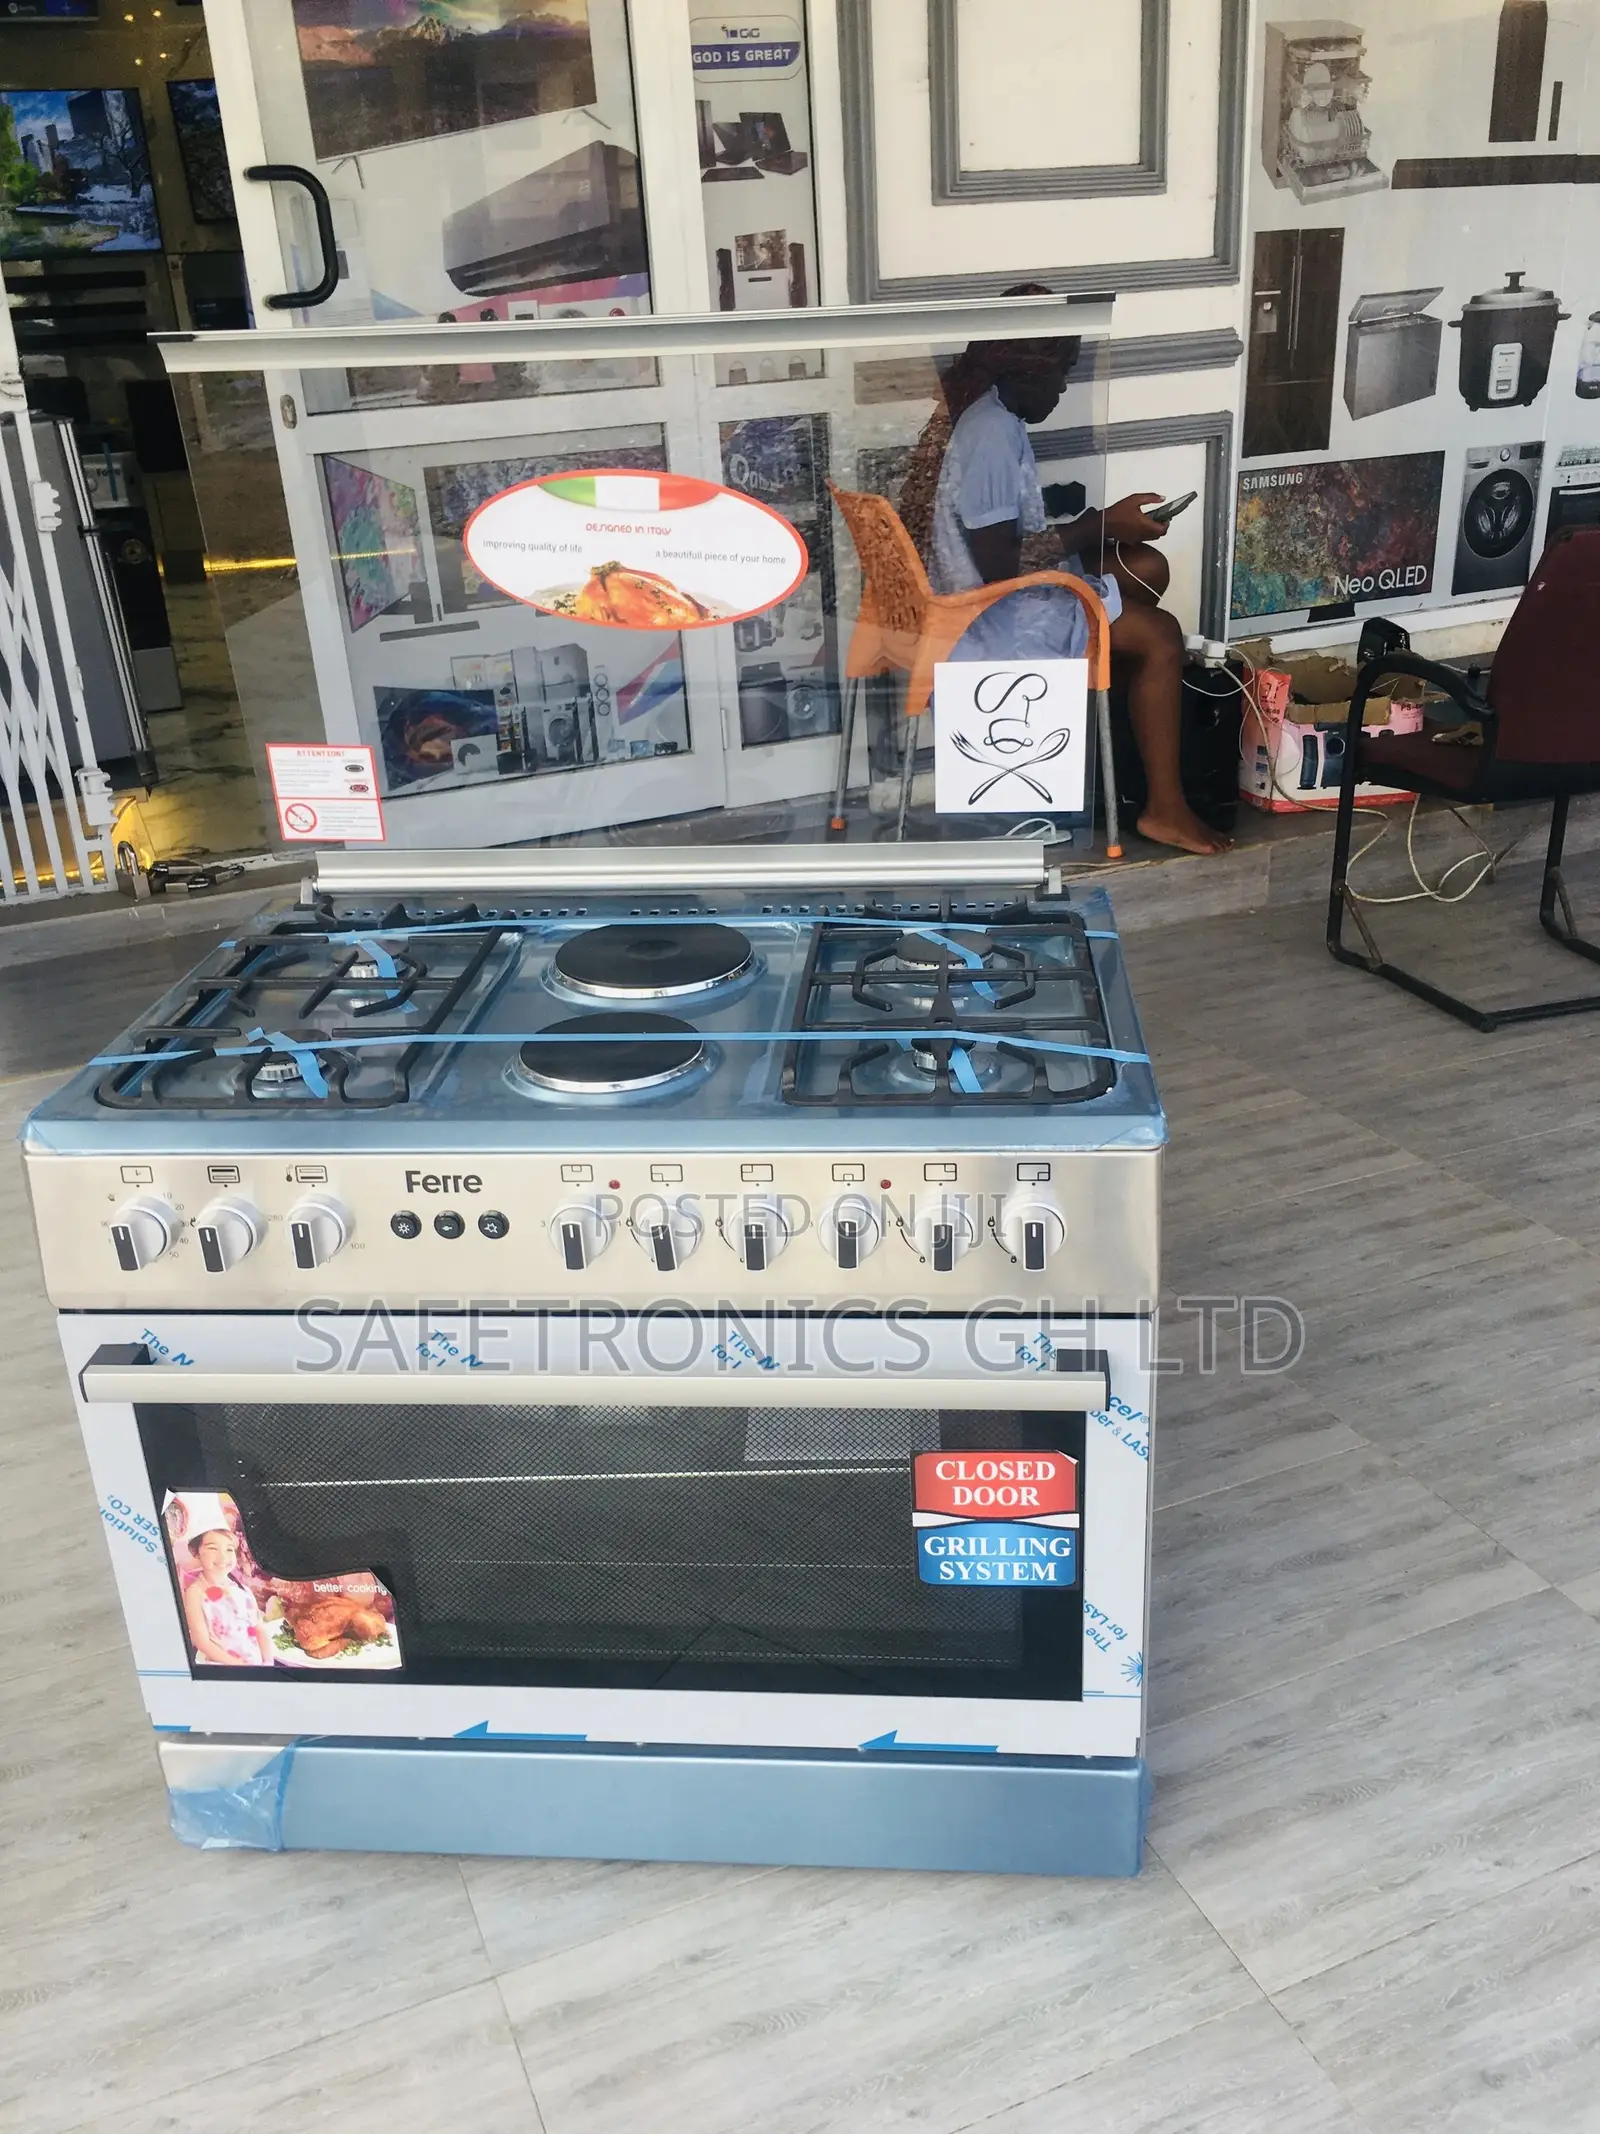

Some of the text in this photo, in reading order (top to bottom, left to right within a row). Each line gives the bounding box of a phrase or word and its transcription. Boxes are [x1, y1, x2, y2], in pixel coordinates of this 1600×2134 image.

[692, 48, 792, 63] GOD IS GREAT
[1242, 472, 1303, 490] SAMSUNG
[585, 523, 672, 536] DESIGNED IN ITALY
[483, 540, 583, 554] improving quality of life
[662, 550, 703, 560] beautifull
[704, 551, 727, 562] piece
[730, 553, 739, 562] of
[740, 554, 760, 564] your
[762, 555, 787, 564] home
[1333, 564, 1427, 596] Neo QLED
[404, 1169, 483, 1194] Ferre
[175, 1203, 185, 1211] 20
[141, 1328, 169, 1355] The
[416, 1342, 439, 1360] for
[431, 1328, 459, 1356] The
[728, 1330, 756, 1358] The
[1033, 1332, 1057, 1360] The
[711, 1344, 734, 1363] for
[1015, 1345, 1038, 1364] for
[1122, 1432, 1149, 1461] LAS
[935, 1460, 1056, 1481] CLOSED
[952, 1486, 1041, 1506] DOOR
[924, 1536, 1072, 1557] GRILLING
[939, 1561, 1057, 1581] SYSTEM
[313, 1581, 388, 1596] better cooking
[1083, 1599, 1109, 1625] LAS
